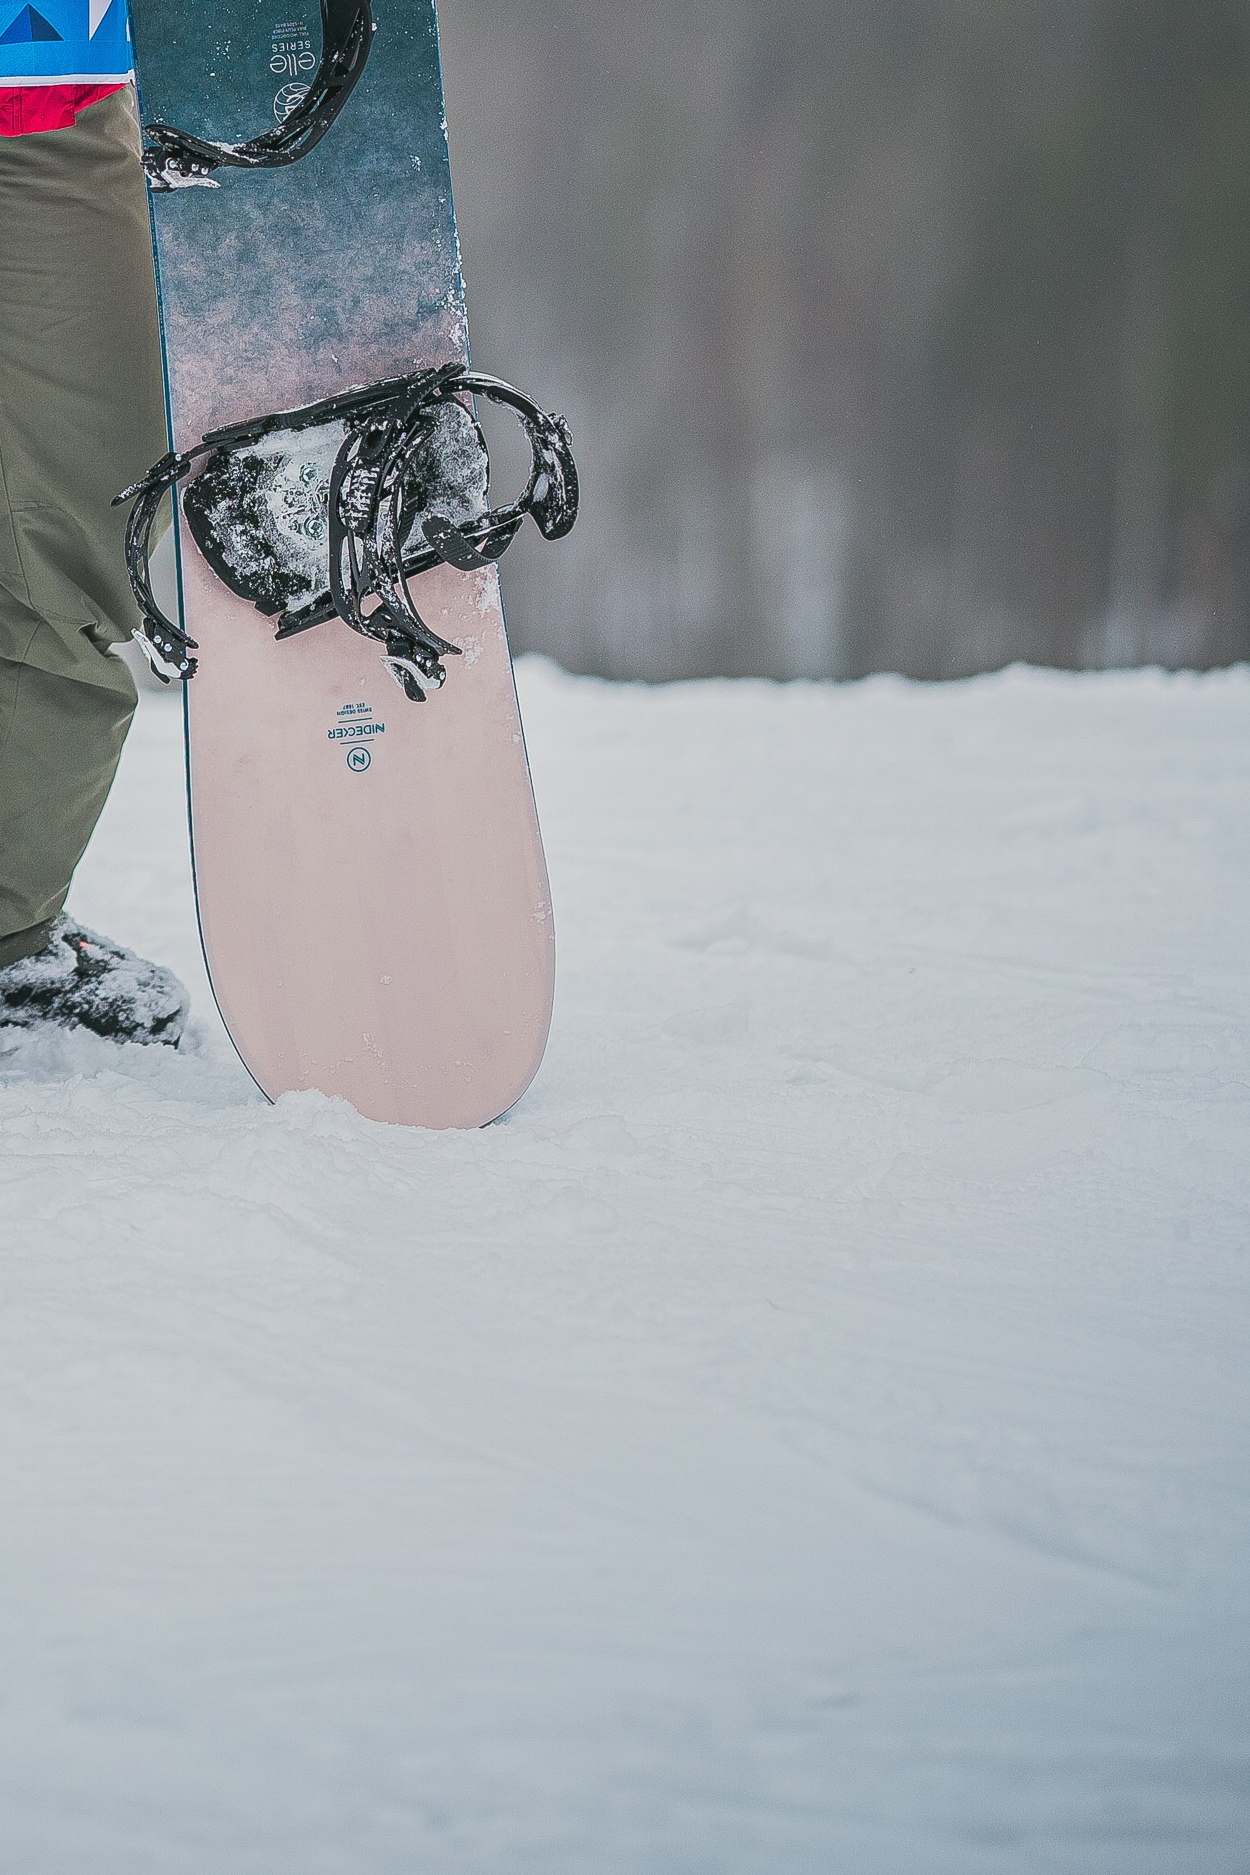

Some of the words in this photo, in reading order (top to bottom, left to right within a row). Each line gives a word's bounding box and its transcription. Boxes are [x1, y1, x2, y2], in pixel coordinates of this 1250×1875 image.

[271, 40, 311, 53] SERIES
[269, 51, 316, 76] elle
[336, 708, 356, 716] DESIGN
[356, 706, 373, 714] SWISS
[327, 722, 385, 739] NIDECKER
